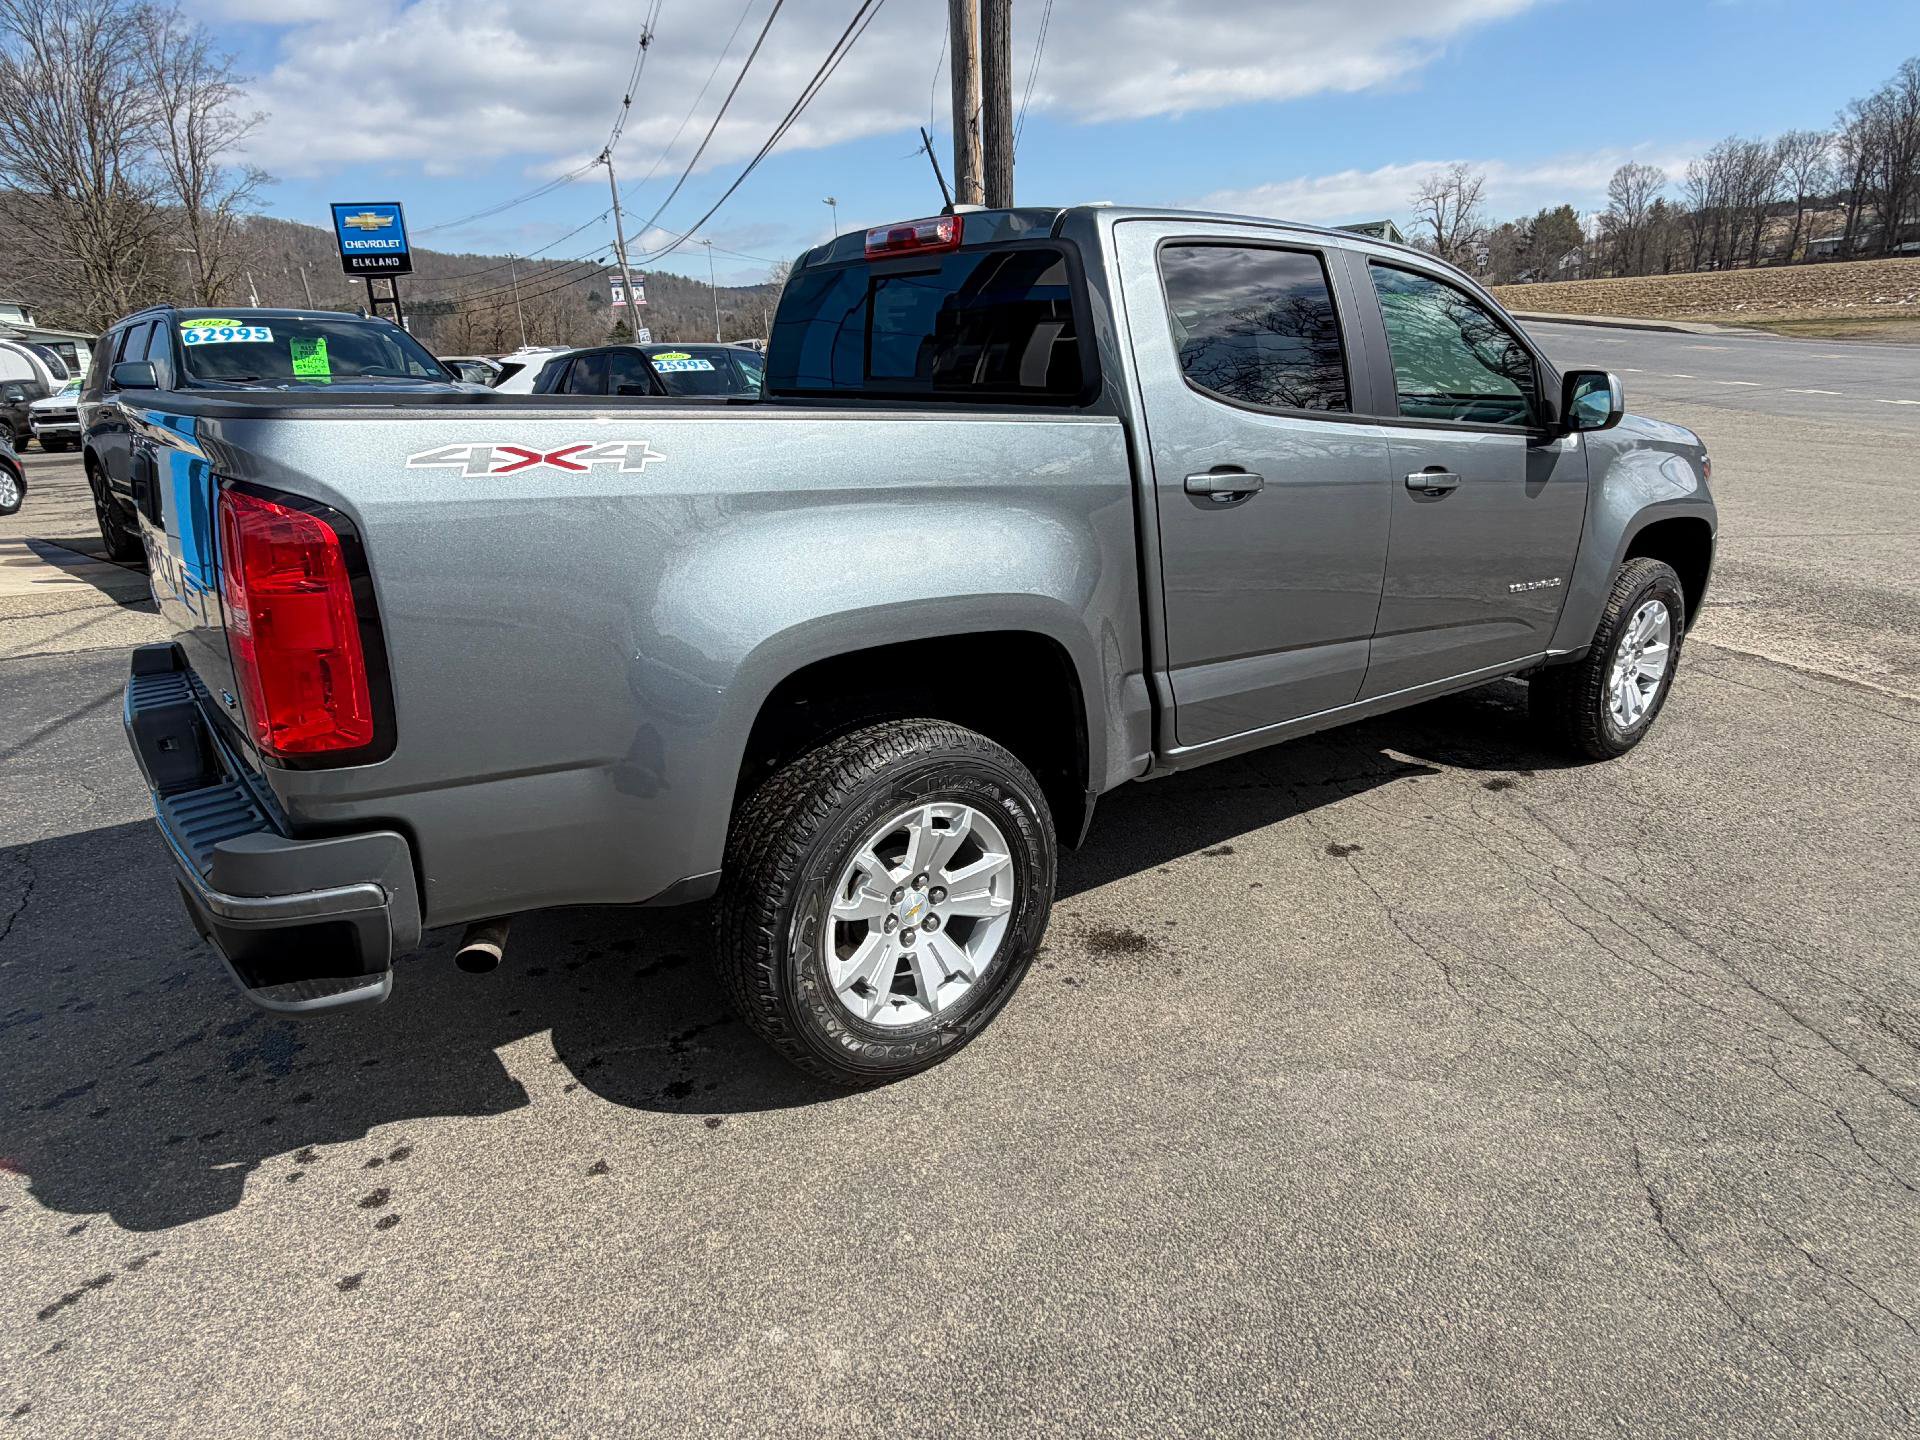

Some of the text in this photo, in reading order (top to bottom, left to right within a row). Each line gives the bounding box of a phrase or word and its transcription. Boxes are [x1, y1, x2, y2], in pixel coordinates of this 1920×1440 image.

[344, 239, 401, 249] CHEVROLET
[352, 257, 400, 267] ELKLAND
[184, 327, 270, 344] 62995
